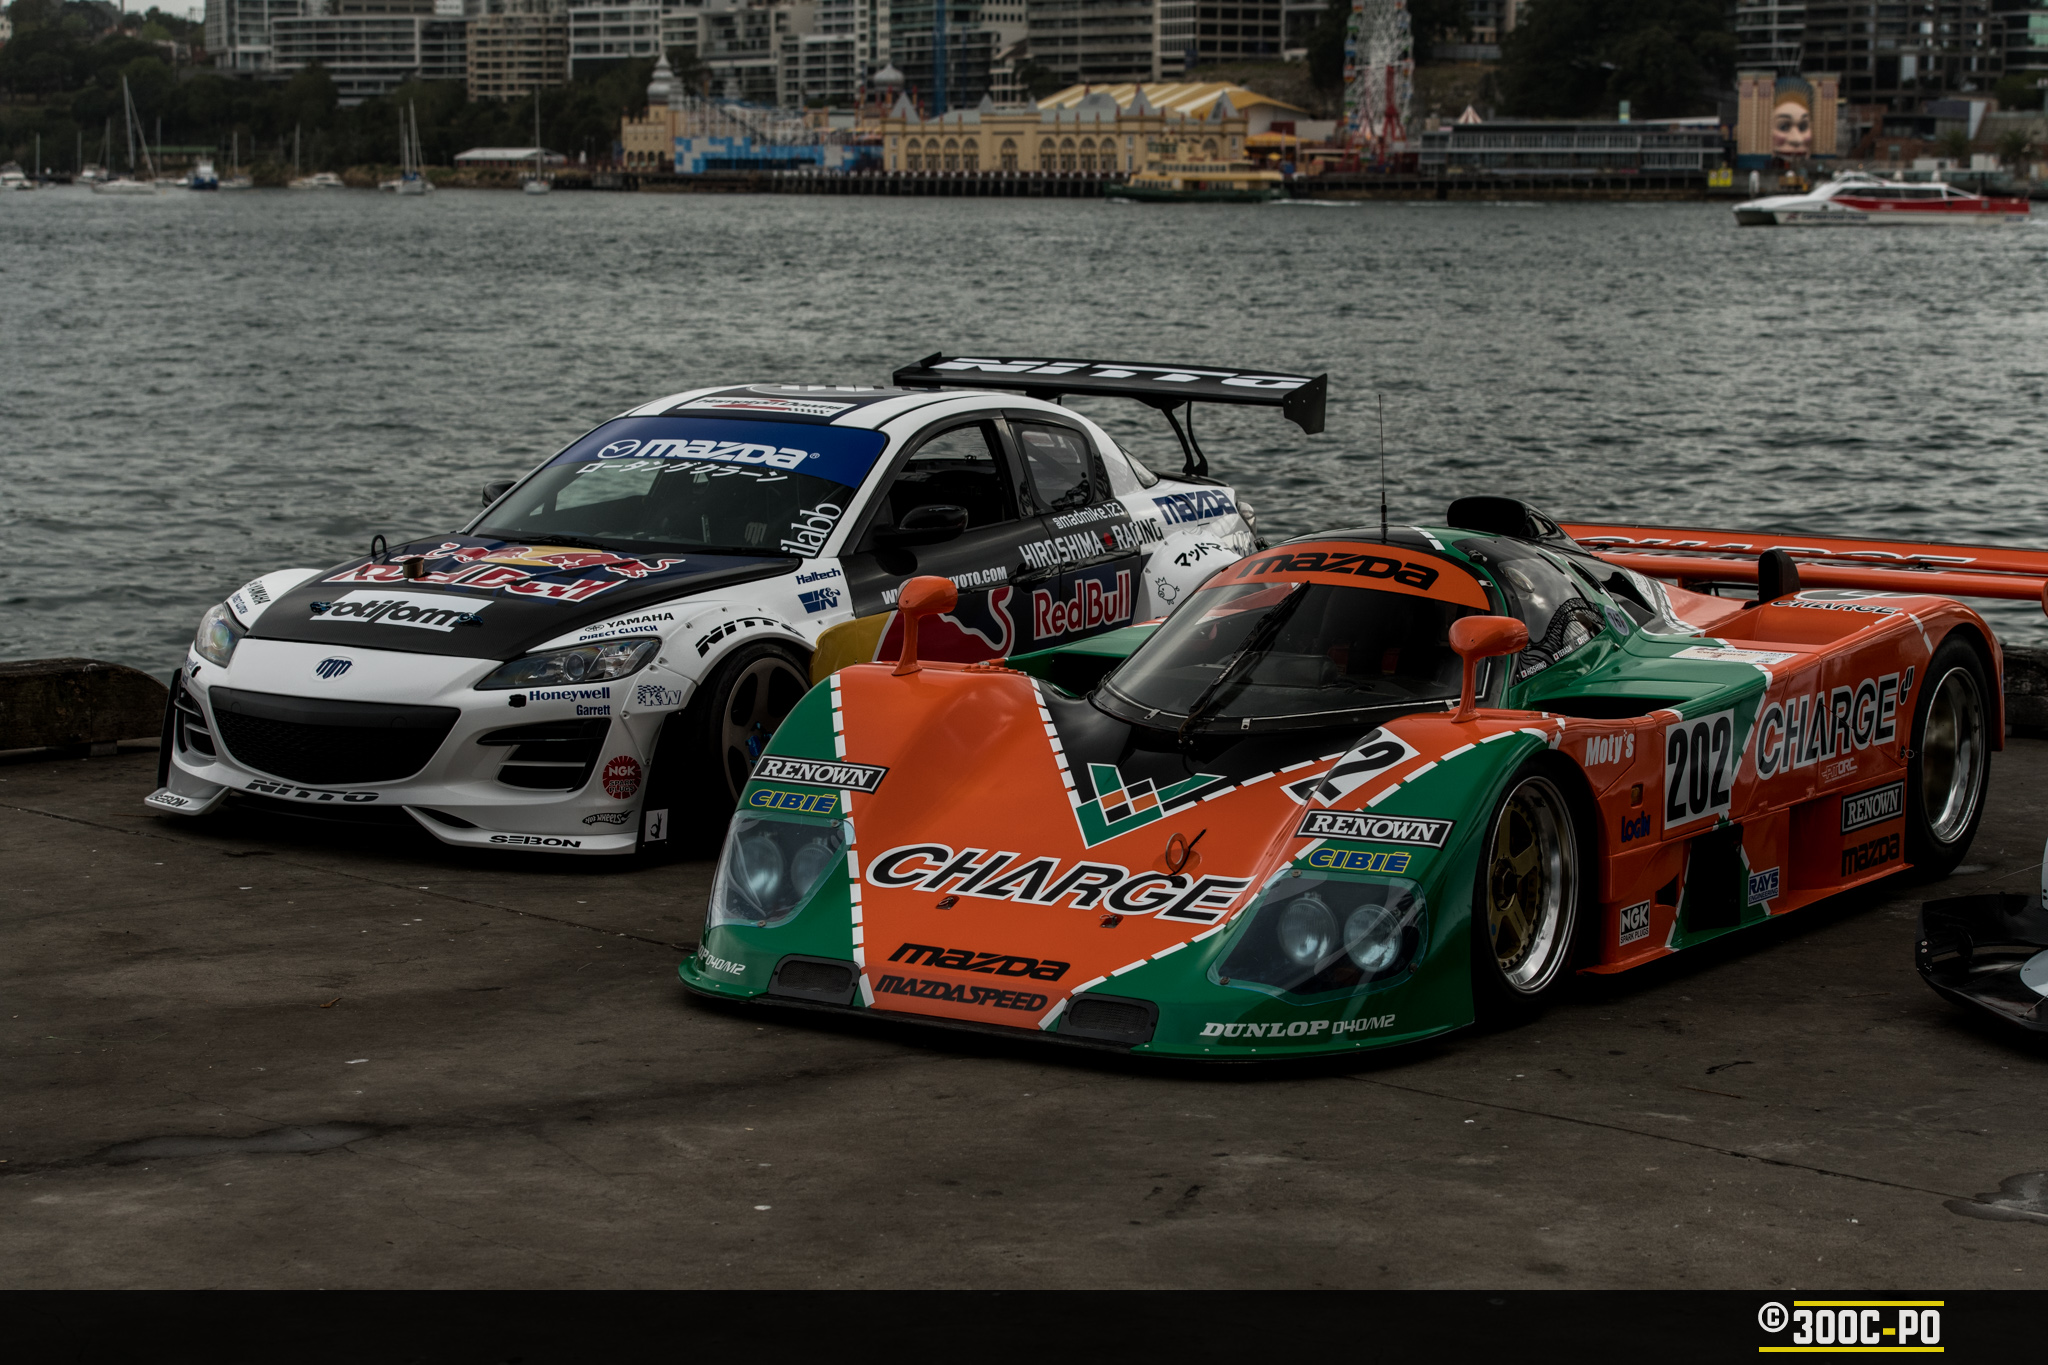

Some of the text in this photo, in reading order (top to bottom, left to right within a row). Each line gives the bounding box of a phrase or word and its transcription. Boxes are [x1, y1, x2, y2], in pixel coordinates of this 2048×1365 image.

[781, 502, 842, 557] ilabb
[1018, 518, 1164, 570] HIROSHIMA RACING
[796, 568, 841, 585] Haltech
[331, 600, 467, 627] rotiform
[1032, 569, 1131, 640] Red Bull
[1771, 600, 1904, 615] CHARGE
[579, 625, 658, 642] DIRECT CLUTCH
[607, 612, 674, 629] YAMAHA
[529, 687, 610, 702] Honeywell
[644, 689, 682, 707] KW
[577, 705, 611, 716] Garrett
[1755, 672, 1900, 781] CHARGE
[609, 765, 636, 777] NGK
[760, 760, 875, 787] RENOWN
[1667, 716, 1731, 823] 202
[749, 788, 839, 814] CIBIÉ
[1847, 788, 1900, 826] RENOWN
[1308, 815, 1440, 844] RENOWN
[1309, 848, 1412, 874] CIBIÉ
[865, 843, 1257, 926] CHARGE
[1749, 871, 1778, 895] RAYS
[1749, 888, 1778, 902] ENGINEERING
[1621, 904, 1648, 933] NGK
[1621, 927, 1649, 944] SPARK PLUGS
[1199, 1020, 1330, 1038] DUNLOP
